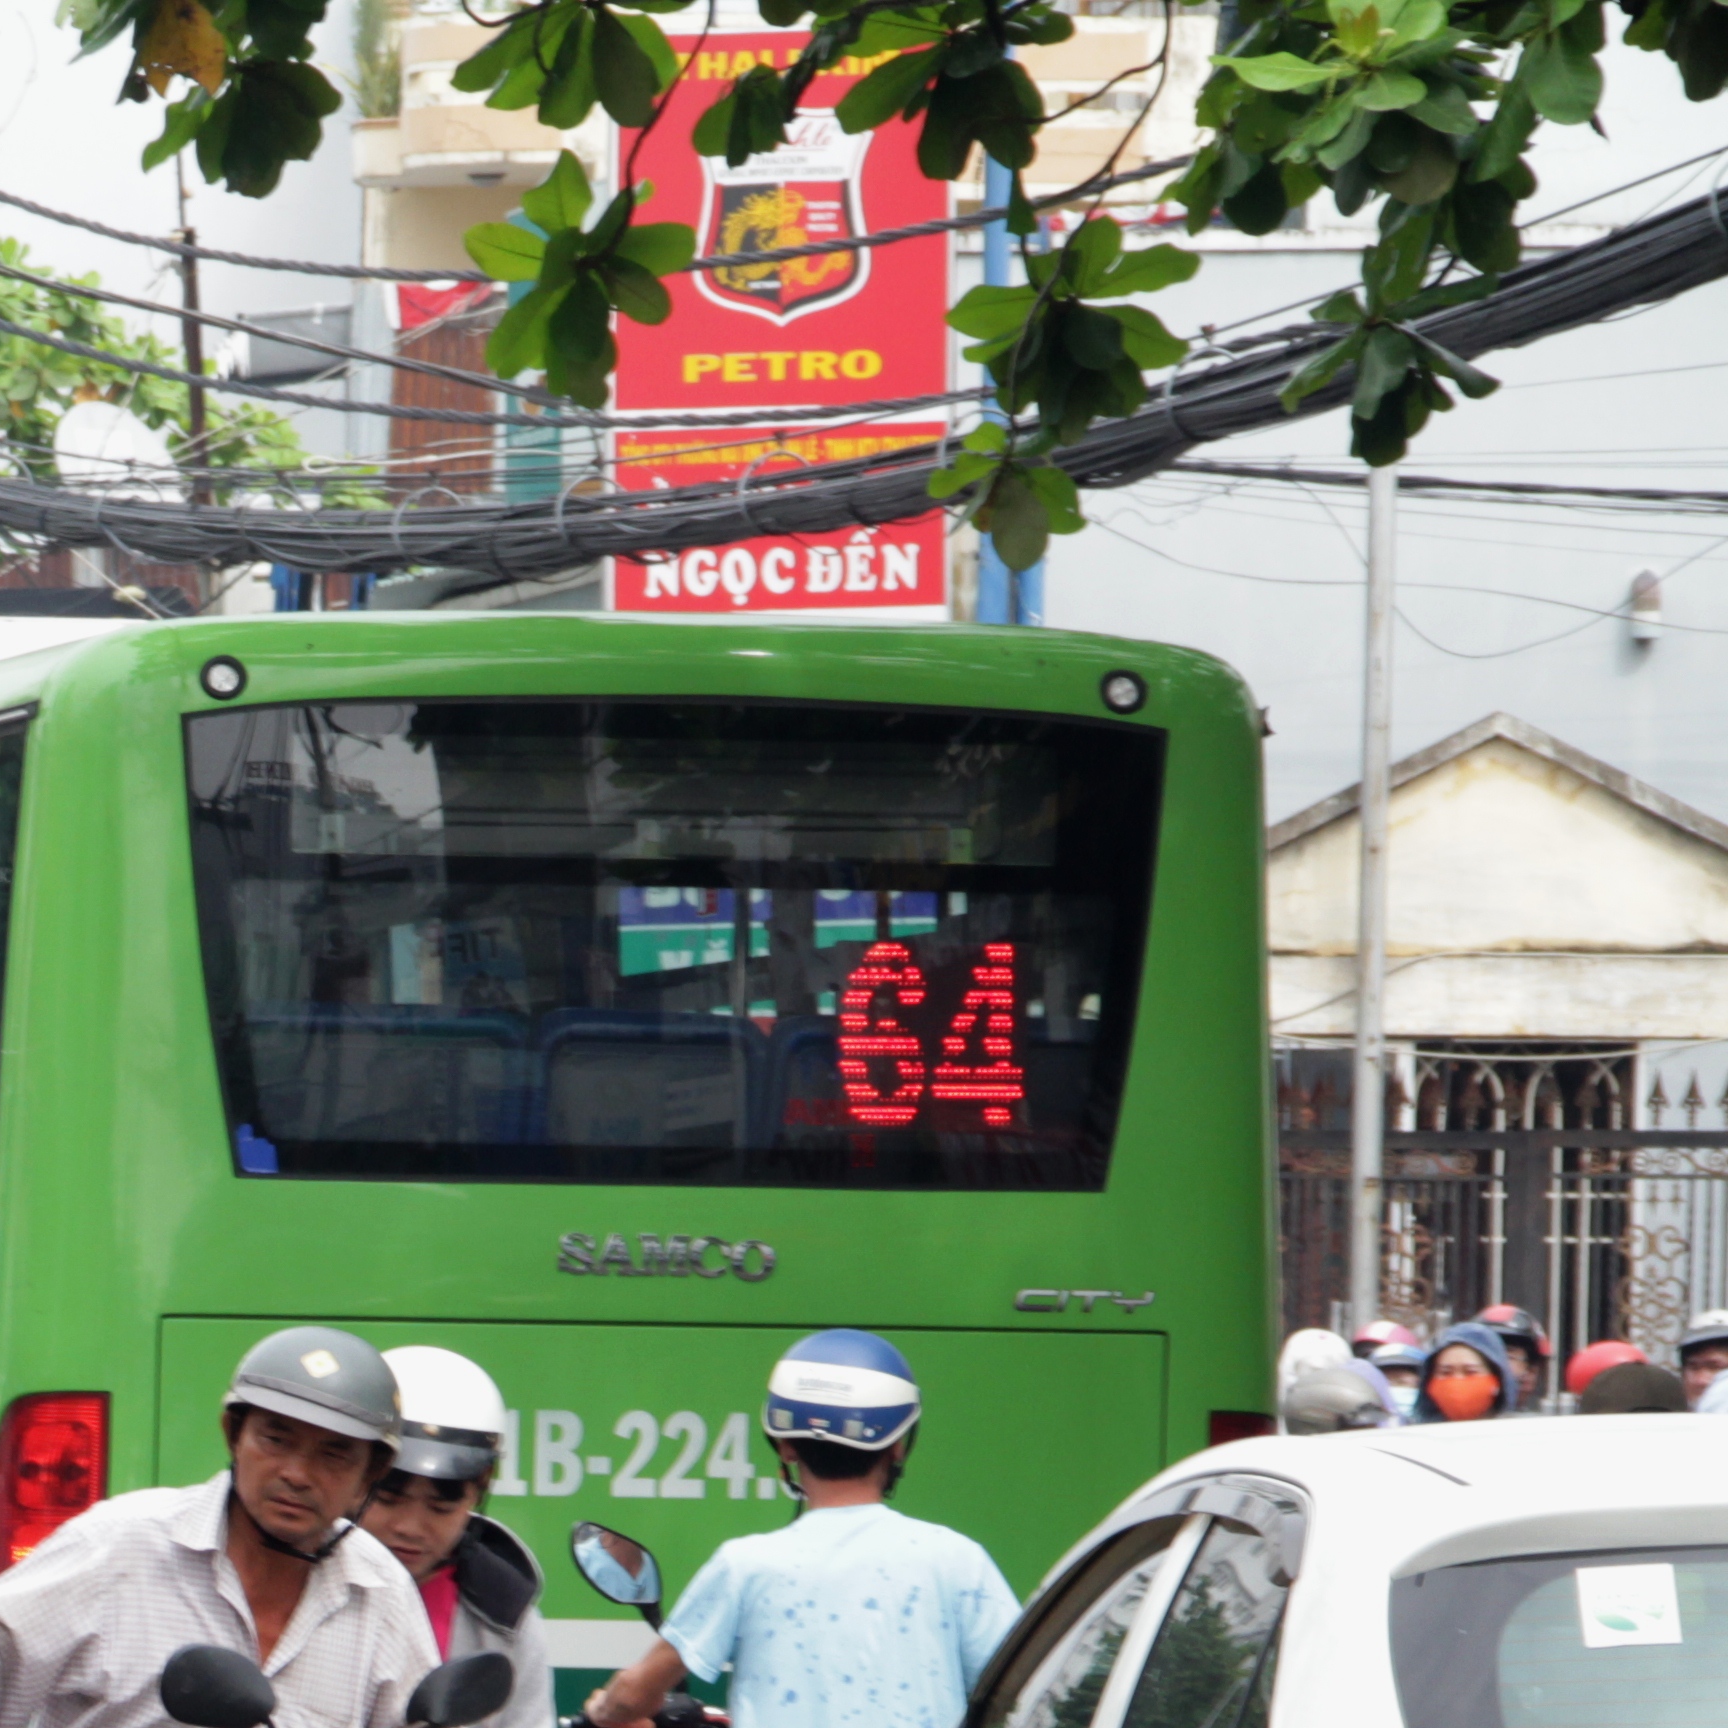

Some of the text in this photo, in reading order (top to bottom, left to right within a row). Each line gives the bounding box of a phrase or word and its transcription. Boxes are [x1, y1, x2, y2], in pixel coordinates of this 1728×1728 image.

[683, 349, 882, 383] PETRO
[643, 547, 795, 606] NGỌC
[839, 942, 1023, 1127] 64
[557, 1232, 775, 1283] SAMCO
[1012, 1289, 1156, 1315] CITY
